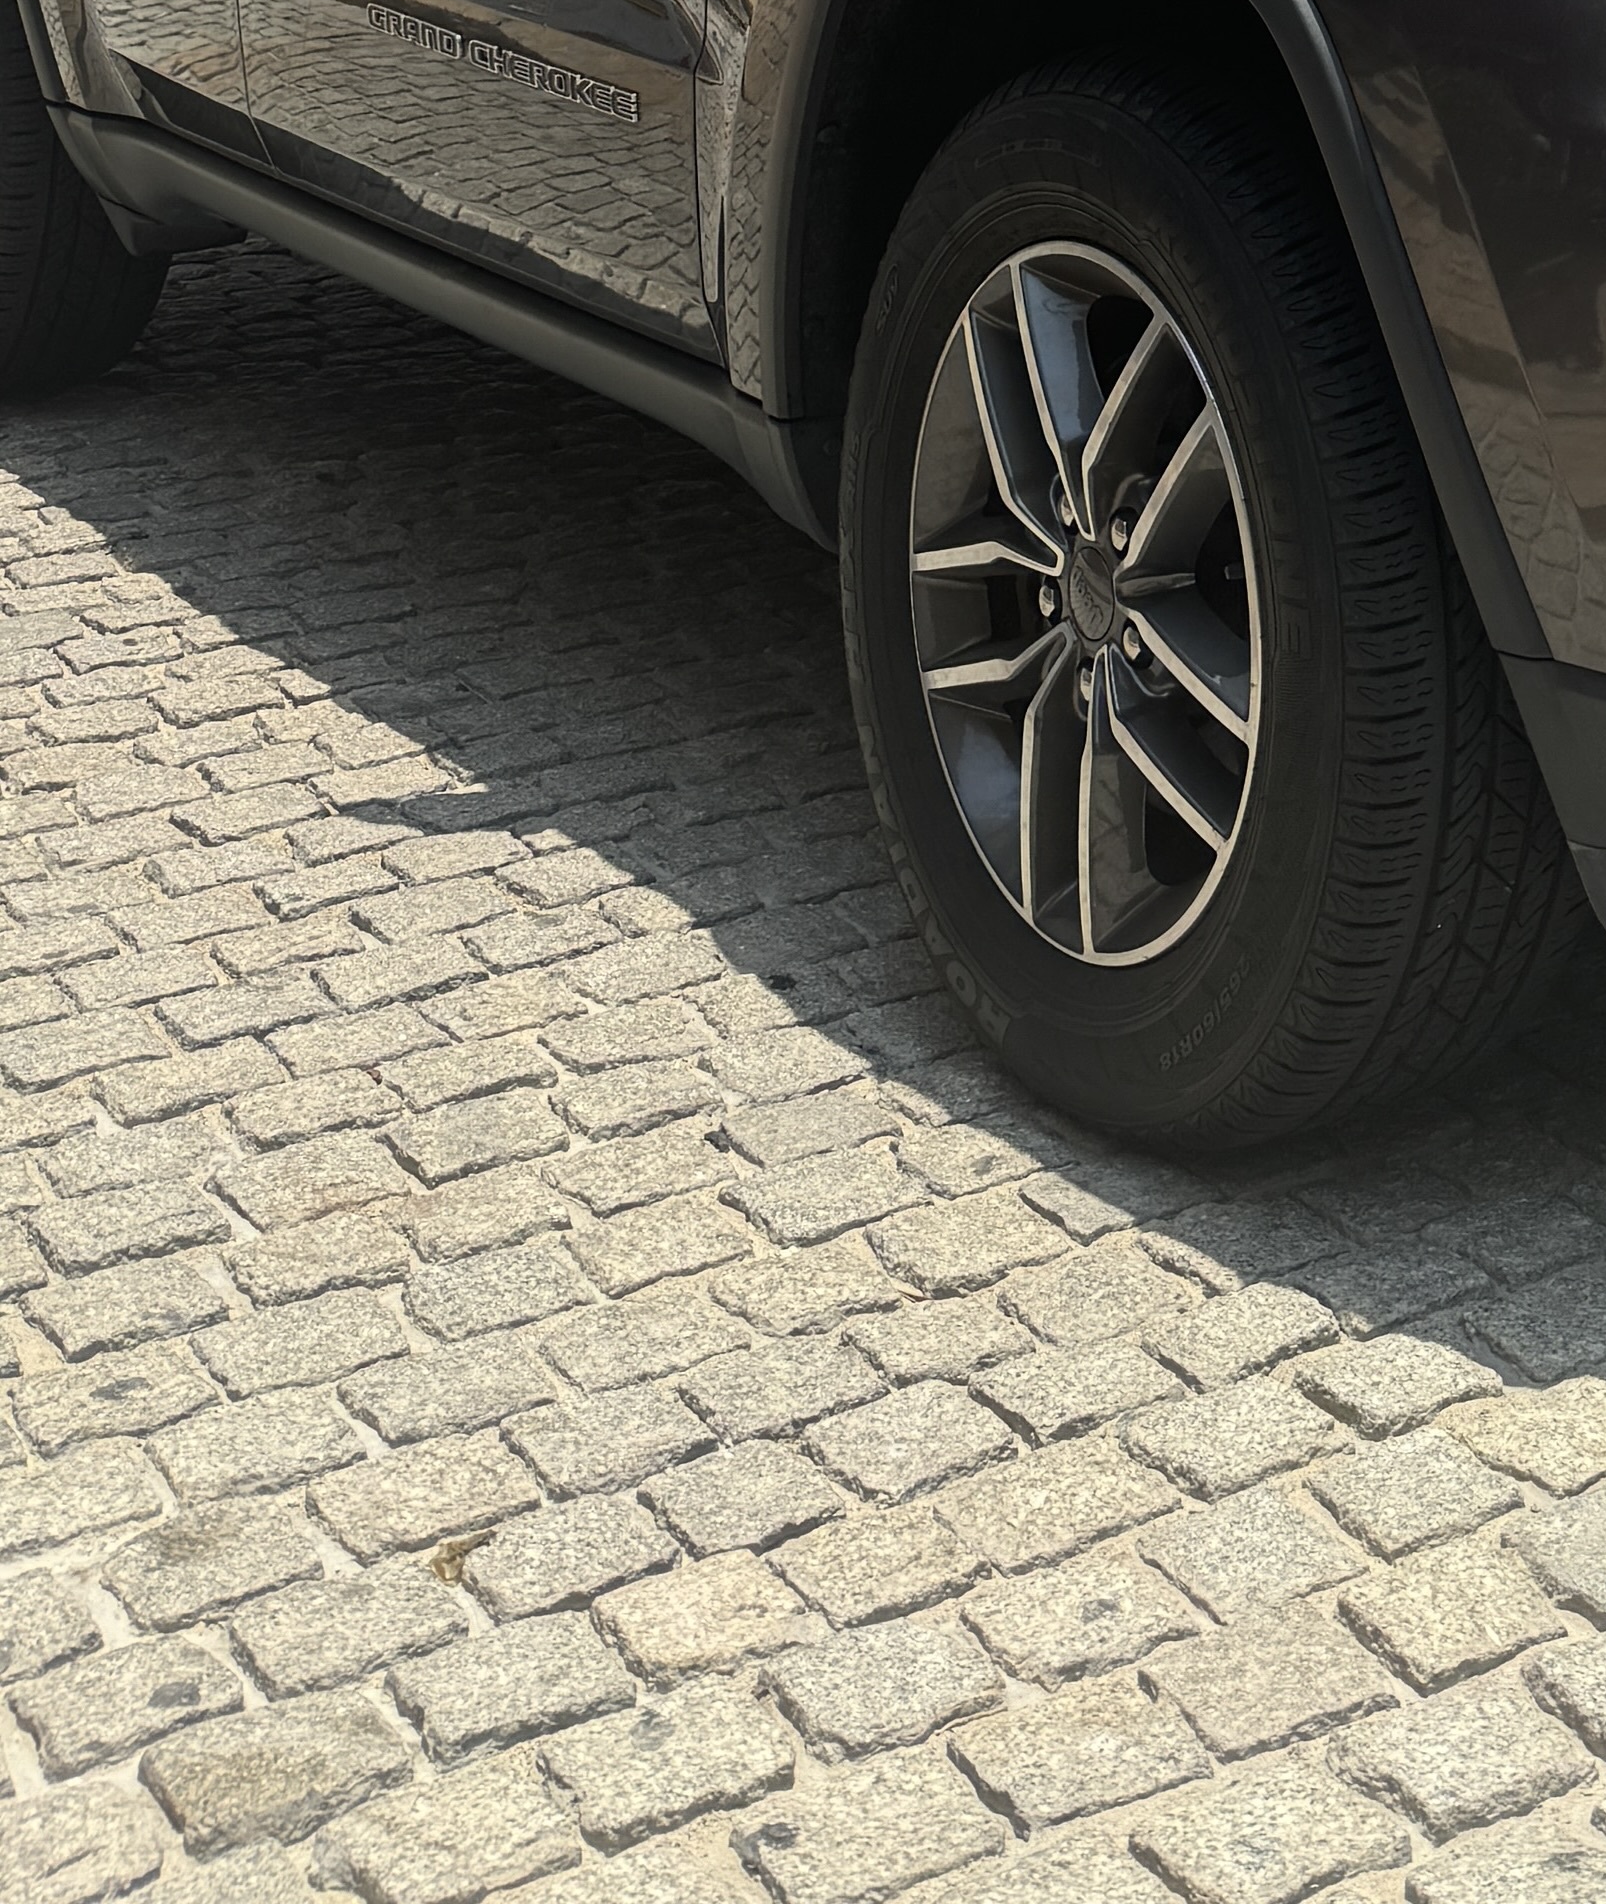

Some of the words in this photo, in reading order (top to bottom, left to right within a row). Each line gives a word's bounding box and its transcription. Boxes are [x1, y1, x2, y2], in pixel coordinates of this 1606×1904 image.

[366, 2, 462, 60] GRAND
[468, 39, 640, 123] CHEROKEE
[874, 266, 899, 336] SUV
[1072, 564, 1104, 638] Jeep
[856, 723, 1010, 1049] ROADIAN
[1158, 952, 1250, 1073] 265/60R18
